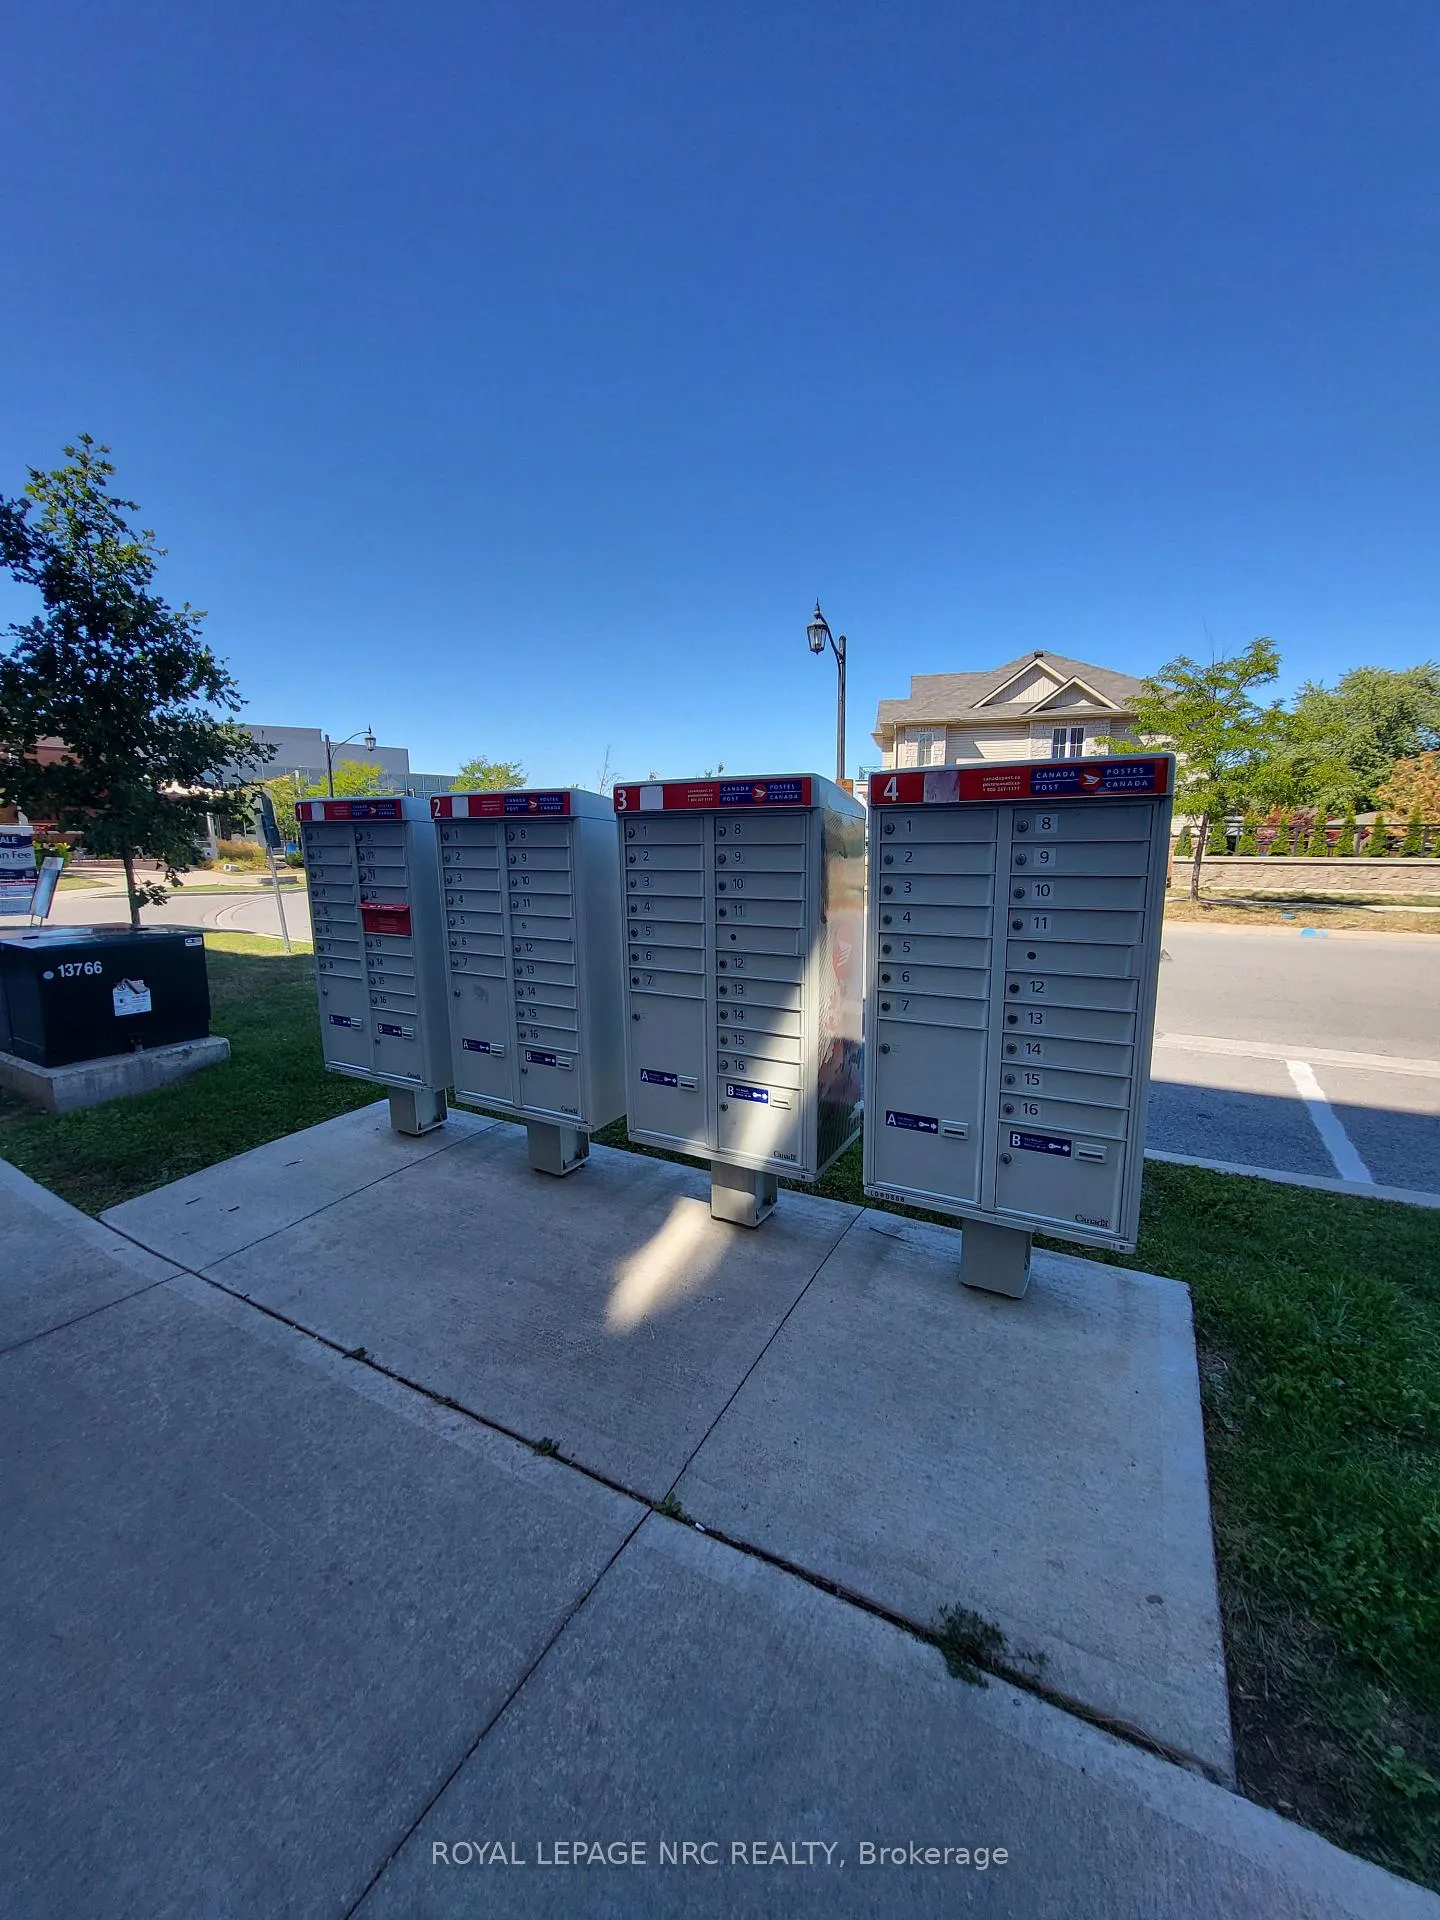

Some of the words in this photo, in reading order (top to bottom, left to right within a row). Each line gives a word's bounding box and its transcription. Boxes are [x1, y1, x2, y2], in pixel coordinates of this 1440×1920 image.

[1036, 771, 1076, 779] CANADA
[1106, 767, 1144, 775] POSTES
[883, 776, 899, 801] 4
[1106, 779, 1148, 788] CANADA
[617, 789, 627, 810] 3
[297, 804, 302, 820] 1
[434, 799, 441, 817] 2
[906, 820, 912, 832] 1
[1041, 817, 1051, 830] 8
[454, 830, 458, 839] 1
[520, 830, 526, 839] 8
[643, 826, 648, 836] 1
[734, 824, 742, 835] 8
[12, 851, 31, 859] Fee
[456, 852, 461, 861] 2
[521, 853, 527, 863] 9
[643, 851, 650, 862] 2
[734, 851, 741, 862] 9
[904, 851, 913, 863] 2
[1039, 851, 1049, 864] 9
[457, 874, 462, 883] 3
[521, 876, 530, 885] 10
[643, 876, 650, 887] 3
[732, 878, 744, 889] 10
[903, 881, 912, 894] 3
[1035, 884, 1051, 897] 10
[458, 895, 464, 904] 4
[523, 898, 531, 907] 11
[644, 902, 651, 912] 4
[734, 906, 744, 916] 11
[460, 916, 465, 925] 5
[902, 911, 912, 923] 4
[1033, 917, 1048, 929] 11
[645, 926, 651, 936] 5
[461, 937, 467, 946] 6
[902, 941, 911, 953] 5
[525, 943, 533, 952] 12
[645, 951, 652, 961] 6
[463, 958, 468, 967] 7
[734, 958, 744, 969] 12
[57, 961, 103, 978] 13766
[526, 965, 535, 974] 13
[646, 975, 653, 985] 7
[901, 971, 910, 983] 6
[527, 987, 536, 997] 14
[733, 984, 744, 995] 13
[1030, 980, 1045, 993] 12
[901, 1000, 910, 1011] 7
[528, 1009, 537, 1018] 15
[733, 1009, 745, 1020] 14
[1028, 1012, 1043, 1025] 13
[529, 1029, 538, 1039] 16
[463, 1040, 469, 1049] A
[734, 1035, 745, 1045] 15
[1026, 1043, 1042, 1055] 14
[526, 1052, 532, 1061] B
[734, 1060, 745, 1070] 16
[641, 1070, 649, 1081] A
[1024, 1073, 1040, 1086] 15
[728, 1085, 734, 1096] B
[1022, 1103, 1038, 1116] 16
[886, 1113, 897, 1126] A
[1012, 1133, 1021, 1146] B
